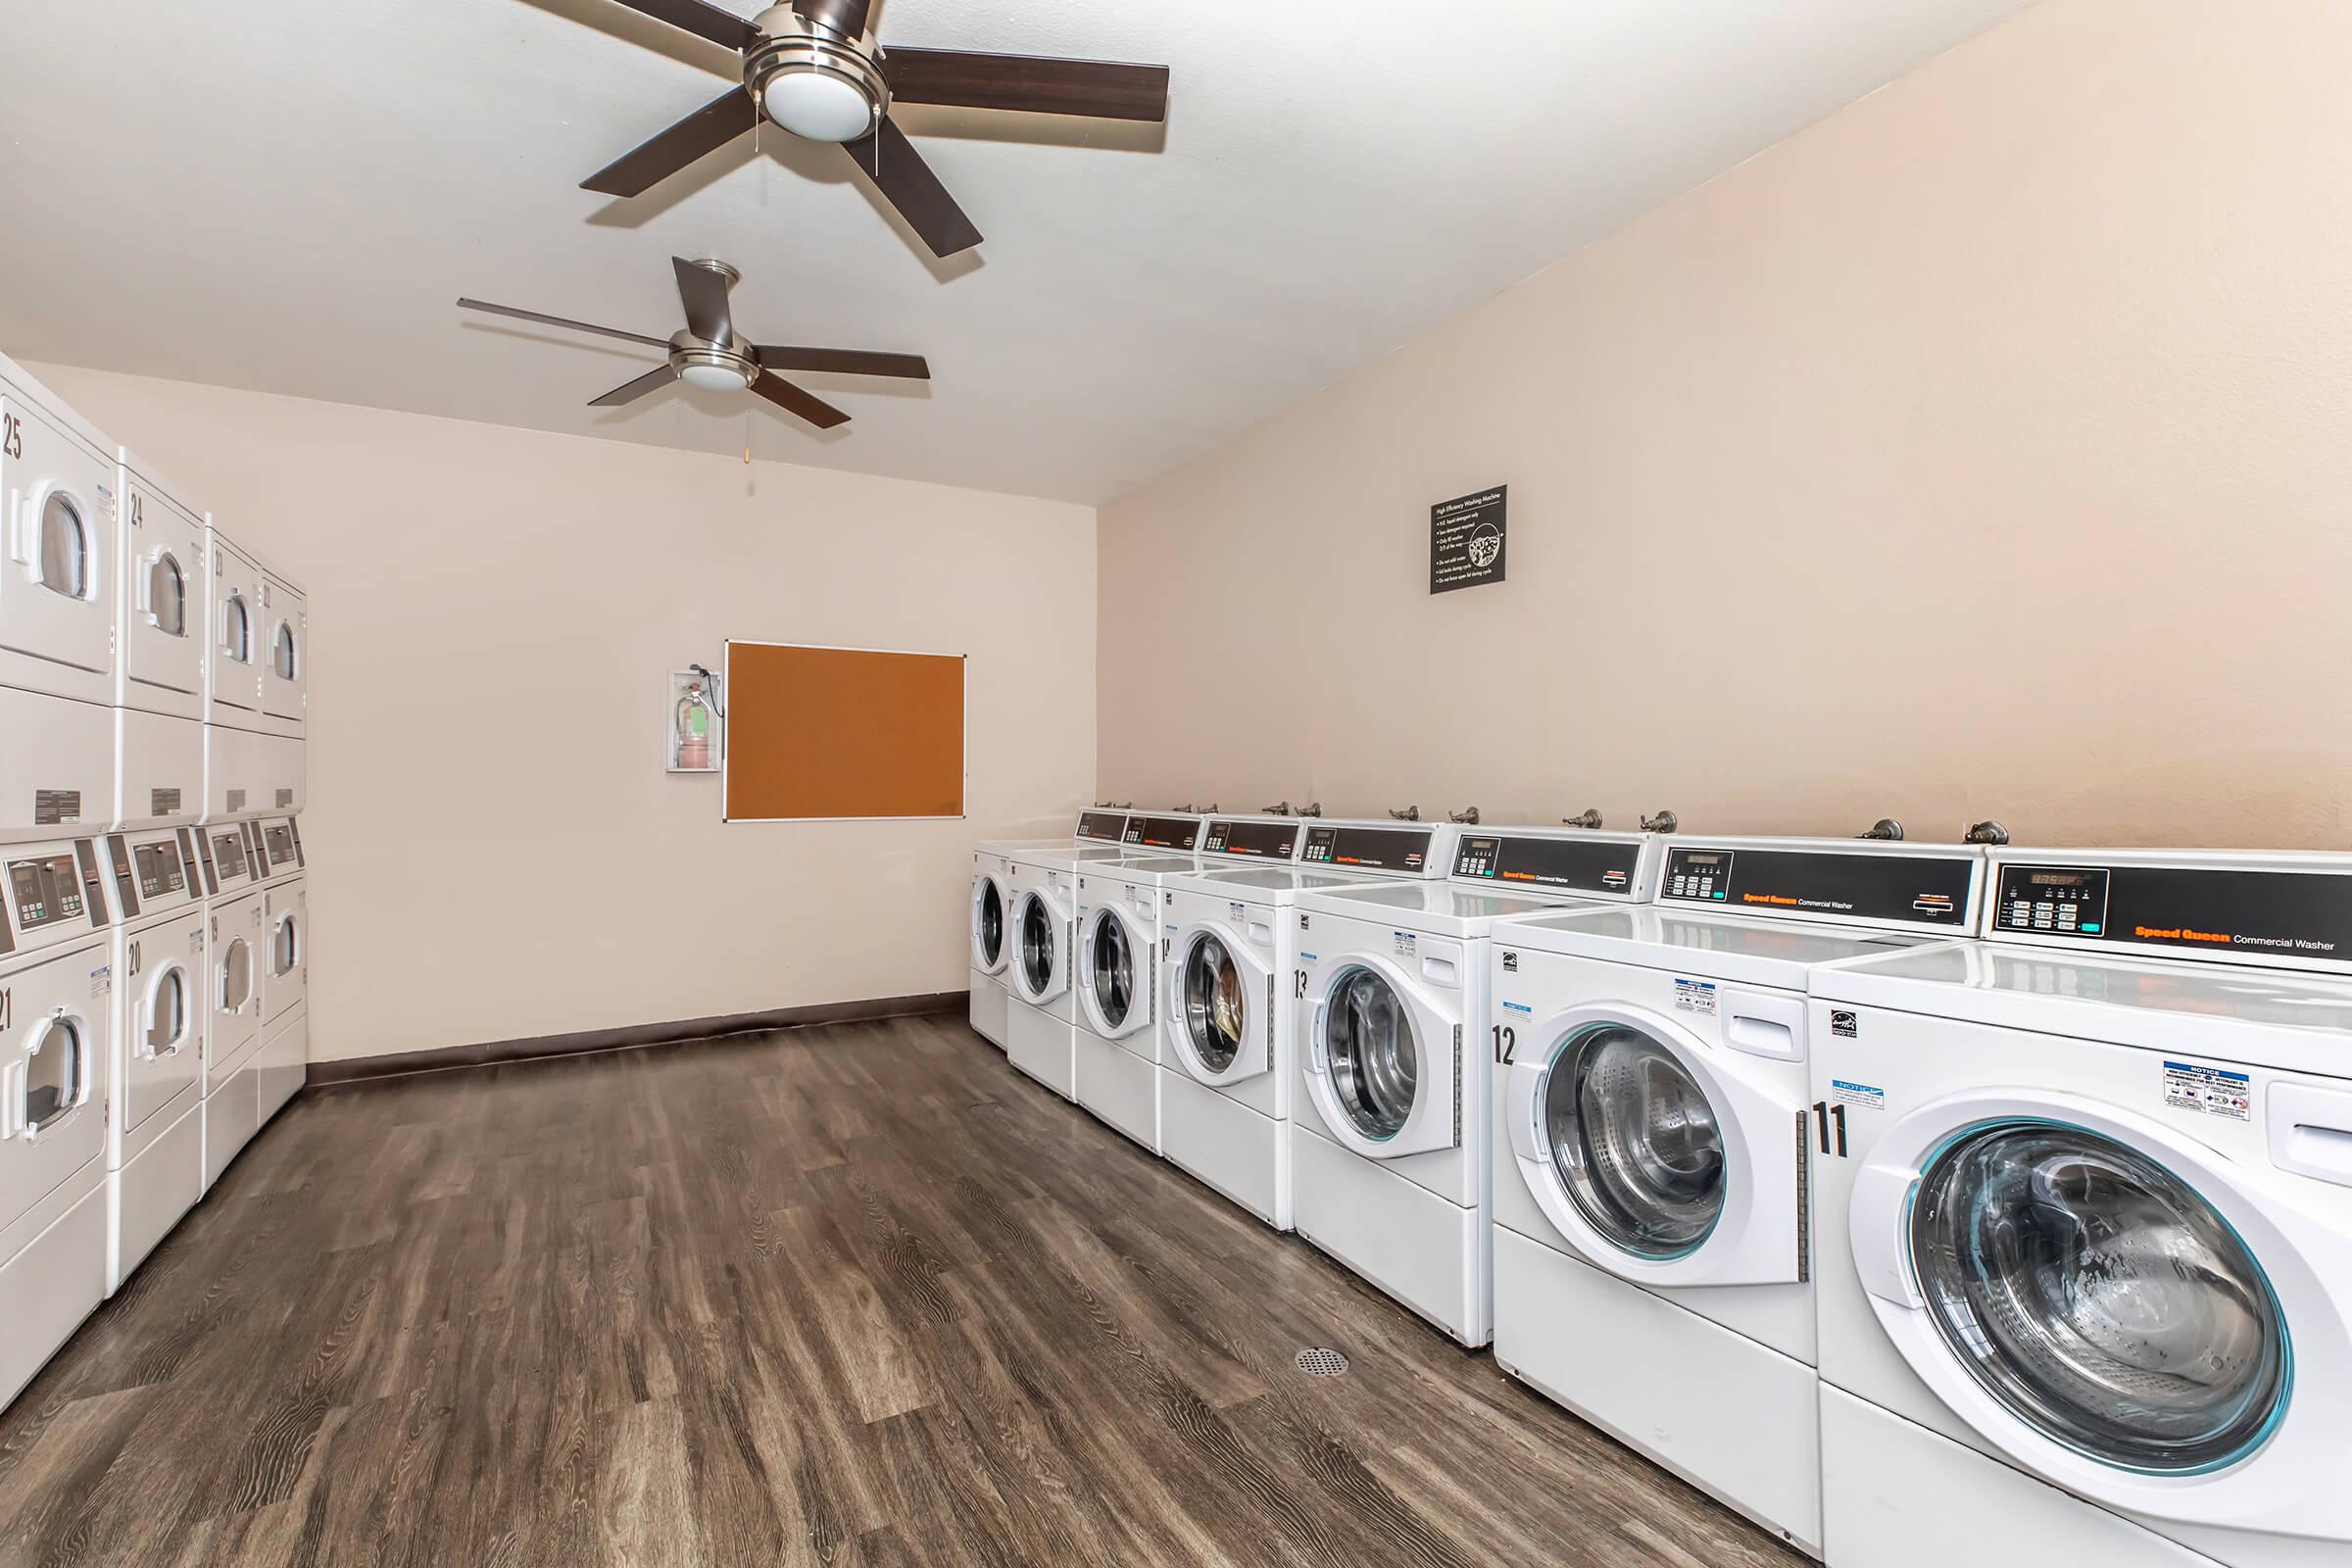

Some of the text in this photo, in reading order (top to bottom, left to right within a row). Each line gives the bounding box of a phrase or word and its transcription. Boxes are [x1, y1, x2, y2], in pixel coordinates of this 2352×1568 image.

[4, 413, 21, 460] 25
[131, 493, 142, 529] 24
[1743, 893, 1853, 910] Speed Queen Commercial Washer
[2134, 926, 2335, 951] Speed Queen Commercial Washer
[128, 941, 140, 976] 20
[1294, 969, 1307, 1000] 13
[1493, 1025, 1515, 1066] 12
[2190, 1066, 2220, 1076] NOTICE
[1813, 1101, 1848, 1158] 11
